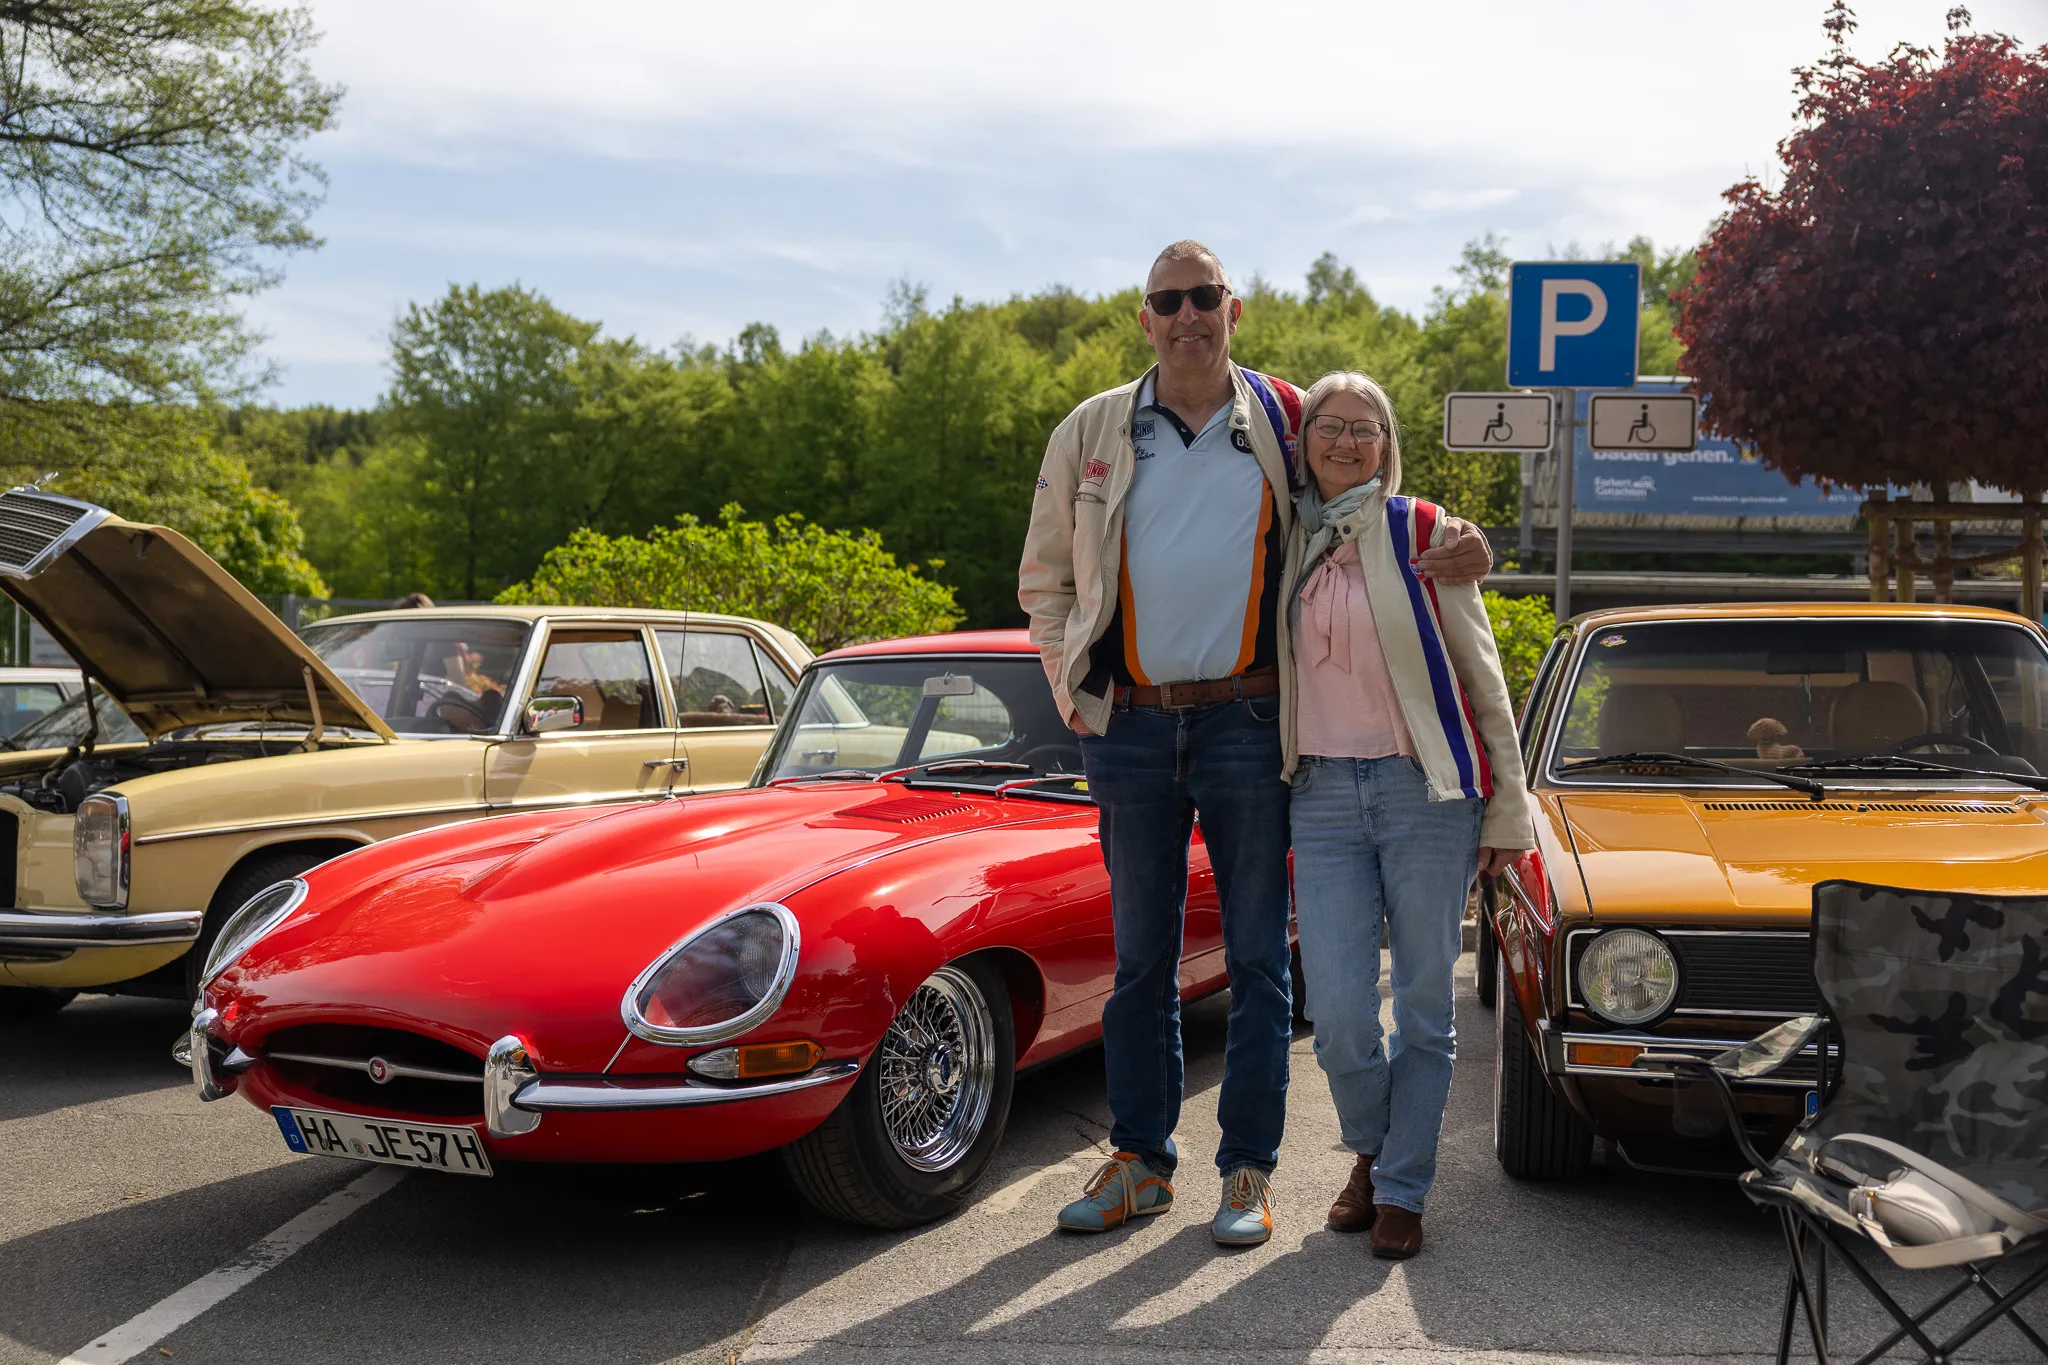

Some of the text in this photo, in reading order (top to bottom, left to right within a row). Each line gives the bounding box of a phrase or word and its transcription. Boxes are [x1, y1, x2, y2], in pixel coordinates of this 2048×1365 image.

[1539, 278, 1608, 372] P
[290, 1133, 300, 1144] D
[295, 1114, 348, 1153] HA
